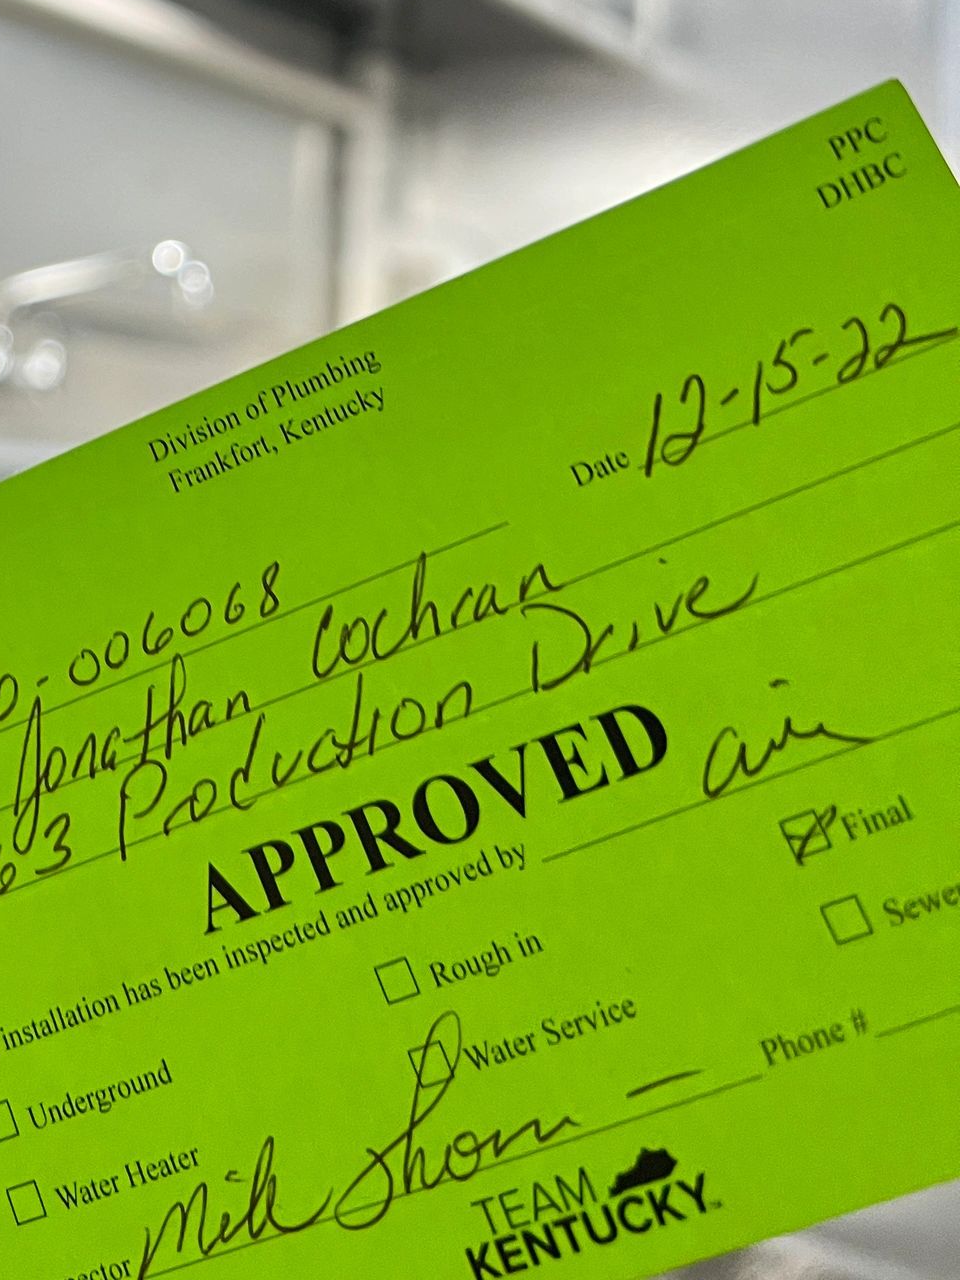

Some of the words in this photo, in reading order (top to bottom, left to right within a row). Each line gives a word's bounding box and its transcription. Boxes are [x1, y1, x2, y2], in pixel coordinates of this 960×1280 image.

[829, 116, 887, 160] PPC
[816, 152, 907, 209] DHBC
[148, 410, 241, 463] Division
[245, 391, 268, 420] of
[272, 351, 381, 408] Plumbing
[168, 435, 278, 492] Frankfort,
[279, 387, 384, 444] Kentucky
[570, 449, 630, 486] Date
[119, 672, 472, 862] Production
[521, 558, 759, 693] Drive
[12, 653, 251, 855] Jonathan
[203, 703, 668, 935] APPROVED
[841, 794, 914, 841] Final
[0, 993, 122, 1052] installation
[121, 975, 163, 1007] has
[164, 955, 221, 992] been
[224, 910, 332, 969] inspected
[335, 892, 380, 929] and
[384, 855, 494, 916] approved
[497, 842, 527, 872] by
[429, 938, 515, 989] Rough
[517, 930, 545, 959] in
[462, 1030, 538, 1071] Water
[540, 997, 638, 1046] Service
[760, 1022, 845, 1067] Phone
[850, 1008, 869, 1036] #
[26, 1058, 174, 1131] Underground
[54, 1175, 120, 1210] Water
[124, 1147, 200, 1189] Heater
[470, 1166, 598, 1235] TEAM
[465, 1171, 707, 1280] KENTUCKY
